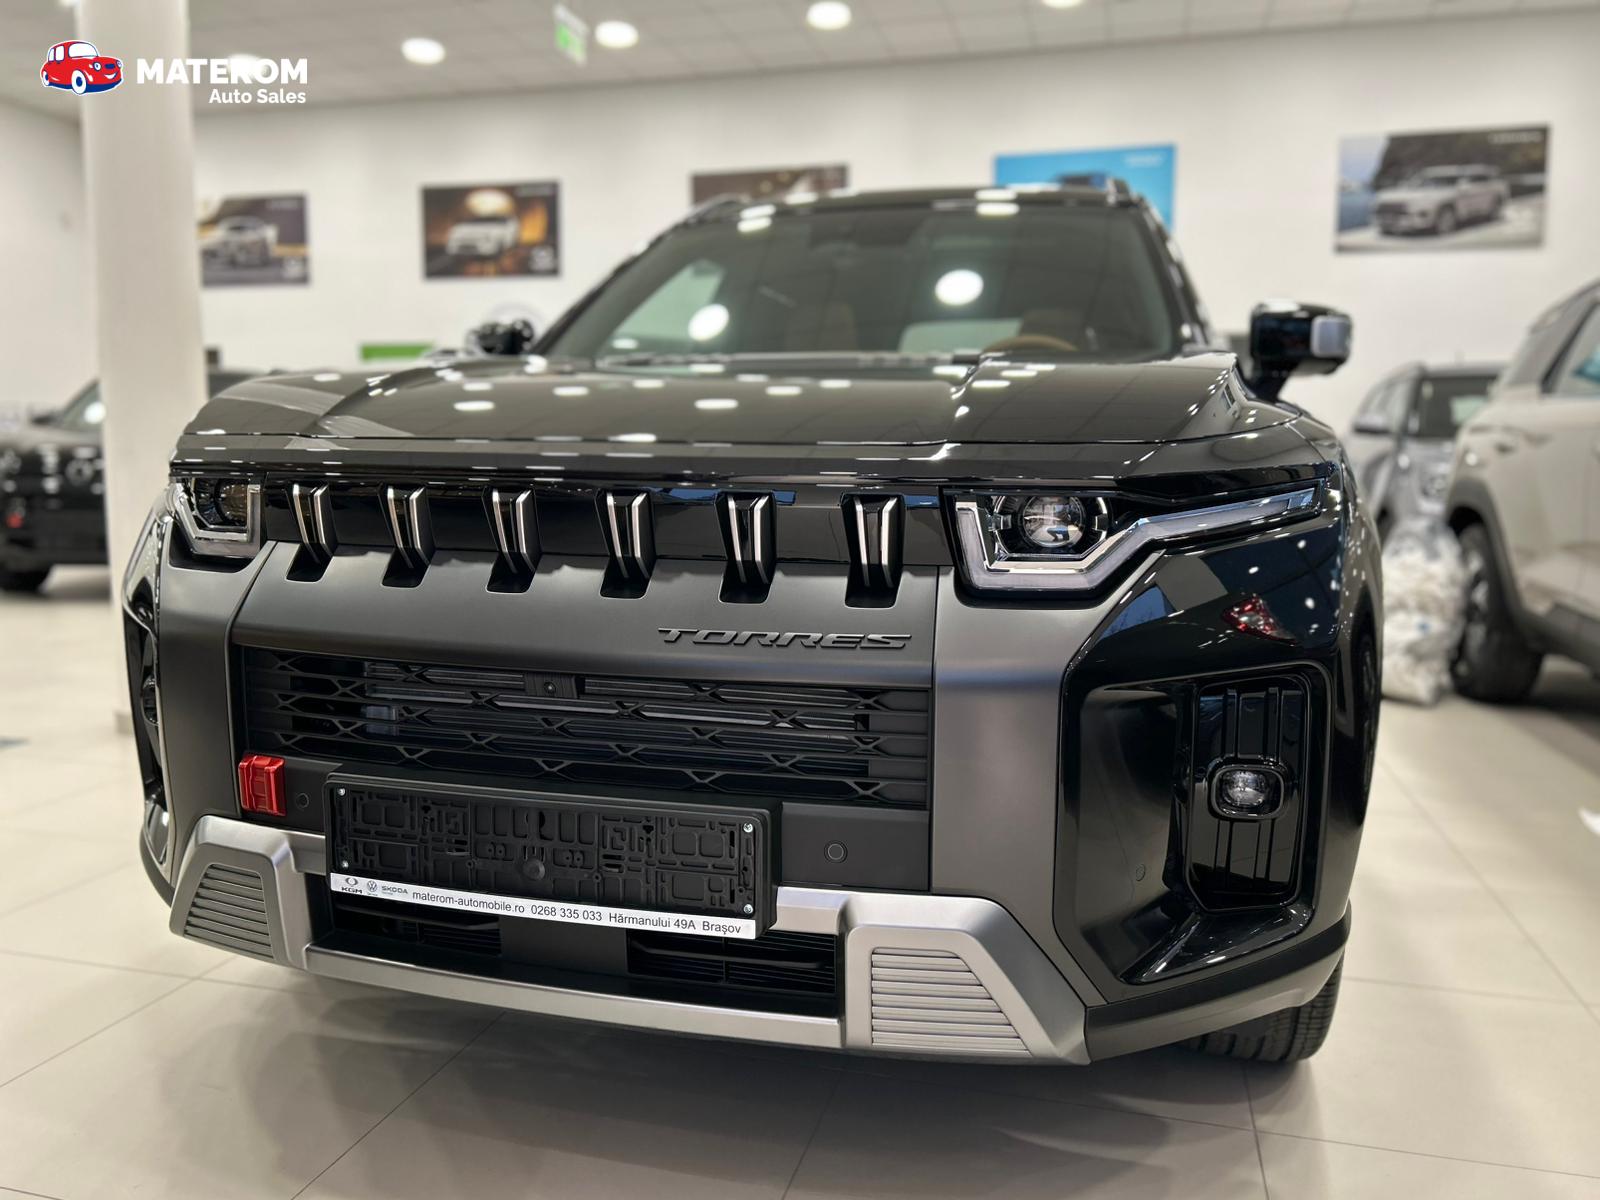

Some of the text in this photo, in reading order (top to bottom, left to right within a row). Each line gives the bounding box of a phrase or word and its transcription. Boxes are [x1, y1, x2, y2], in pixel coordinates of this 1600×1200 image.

[657, 627, 912, 649] TORRES
[412, 891, 525, 913] materom-automobile.ro
[530, 904, 557, 916] 0268
[560, 908, 579, 919] 335
[582, 910, 602, 921] 033
[609, 912, 671, 928] Hărmanului
[673, 918, 696, 930] 49A
